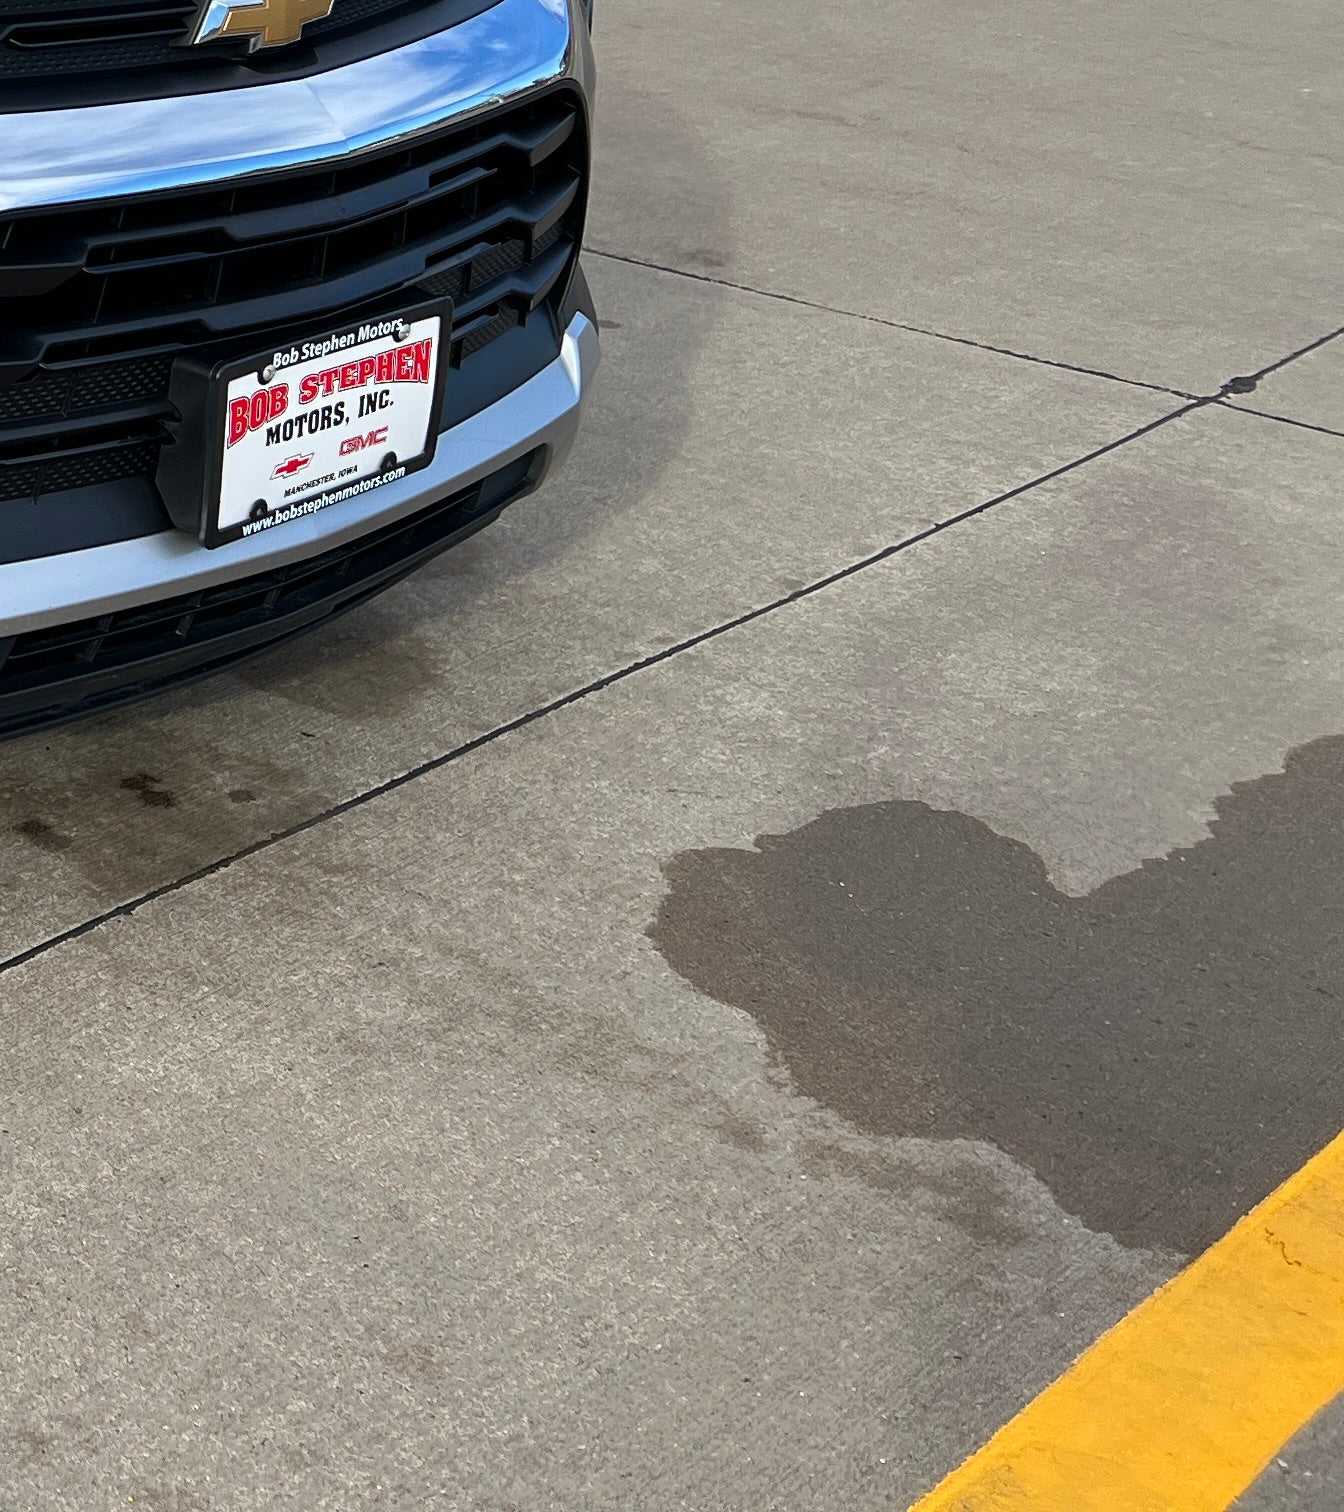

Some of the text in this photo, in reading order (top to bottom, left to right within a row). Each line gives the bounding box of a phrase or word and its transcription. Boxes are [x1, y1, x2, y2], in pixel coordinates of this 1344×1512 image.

[272, 317, 404, 369] Bob Stephen Motors
[227, 337, 433, 450] BOB STEPHEN
[265, 389, 394, 447] MOTORS, INC.
[338, 425, 389, 457] GMC
[242, 465, 406, 537] www.bobstephenmotors.com
[283, 464, 358, 498] MANCHESTER, IOWA
